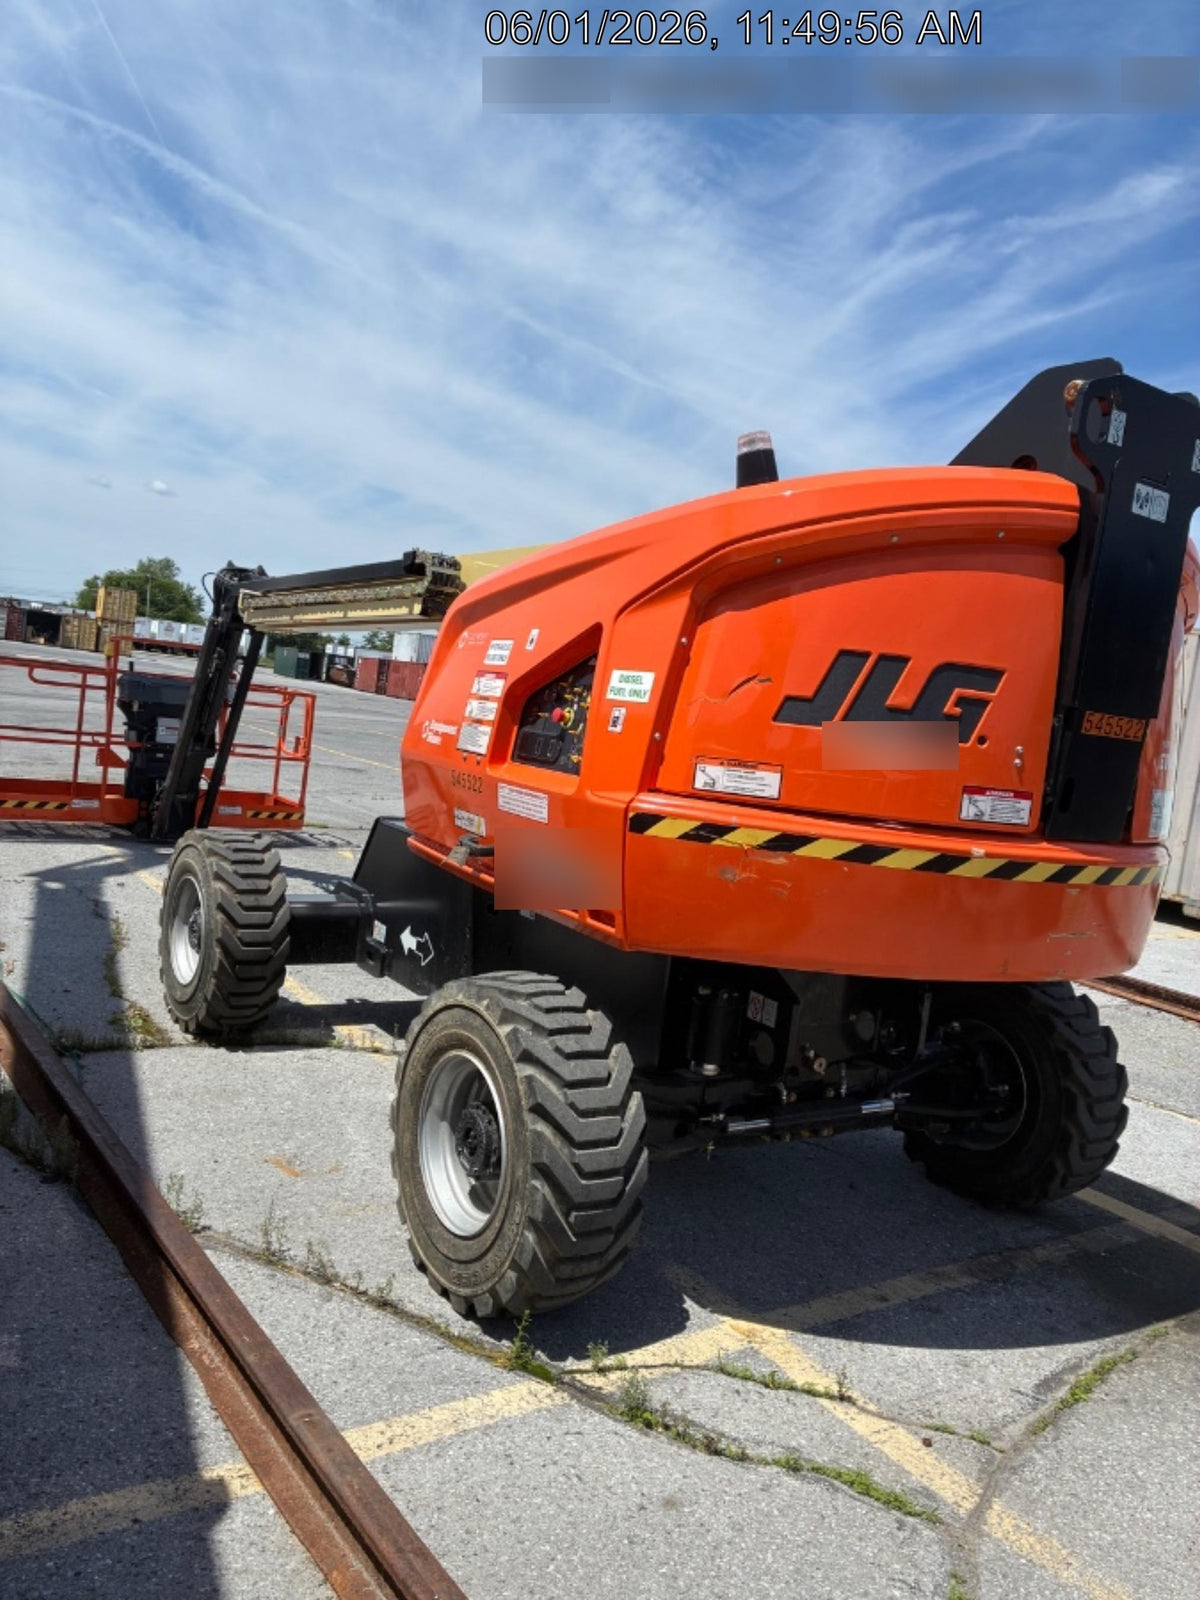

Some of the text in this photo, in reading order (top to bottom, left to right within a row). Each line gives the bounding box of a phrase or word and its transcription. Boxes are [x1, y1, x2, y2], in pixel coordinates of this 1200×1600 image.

[609, 685, 650, 699] FUEL ONLY
[618, 673, 643, 685] DIESEL
[773, 648, 1006, 746] JLG
[1084, 712, 1146, 740] 545522
[450, 768, 483, 794] 545522
